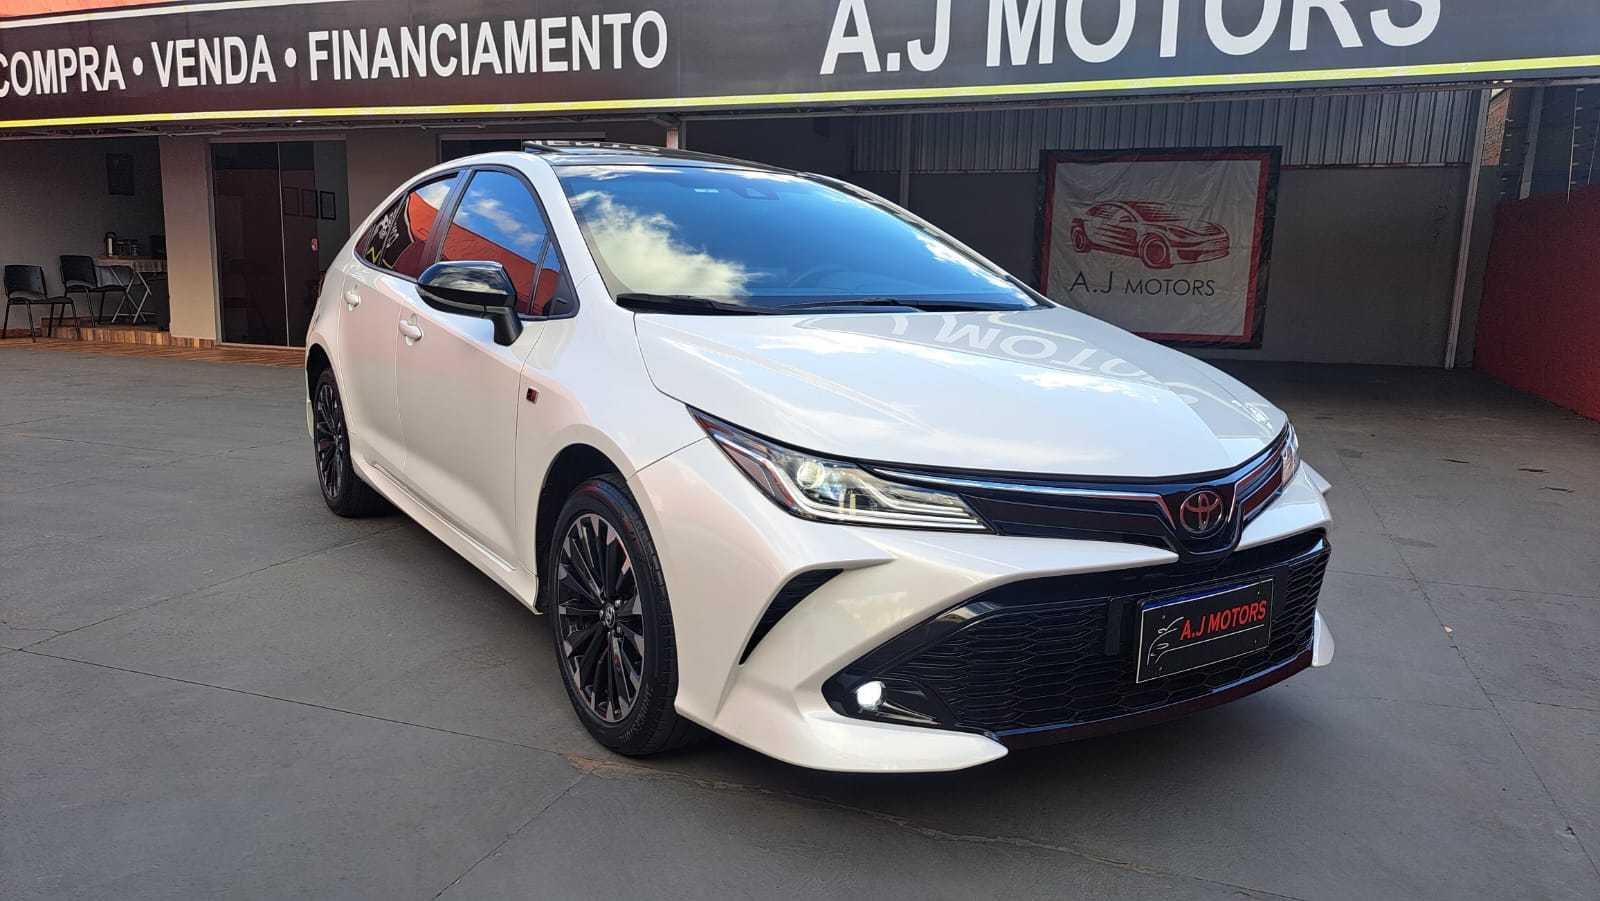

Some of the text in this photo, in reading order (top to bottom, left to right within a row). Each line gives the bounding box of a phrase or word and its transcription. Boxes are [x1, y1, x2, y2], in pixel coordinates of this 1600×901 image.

[150, 34, 277, 88] VENDA
[308, 10, 668, 81] FINANCIAMENTO
[820, 0, 951, 75] A.J
[1070, 270, 1216, 296] A.J MOTORS
[1180, 600, 1267, 640] A.J MOTORS
